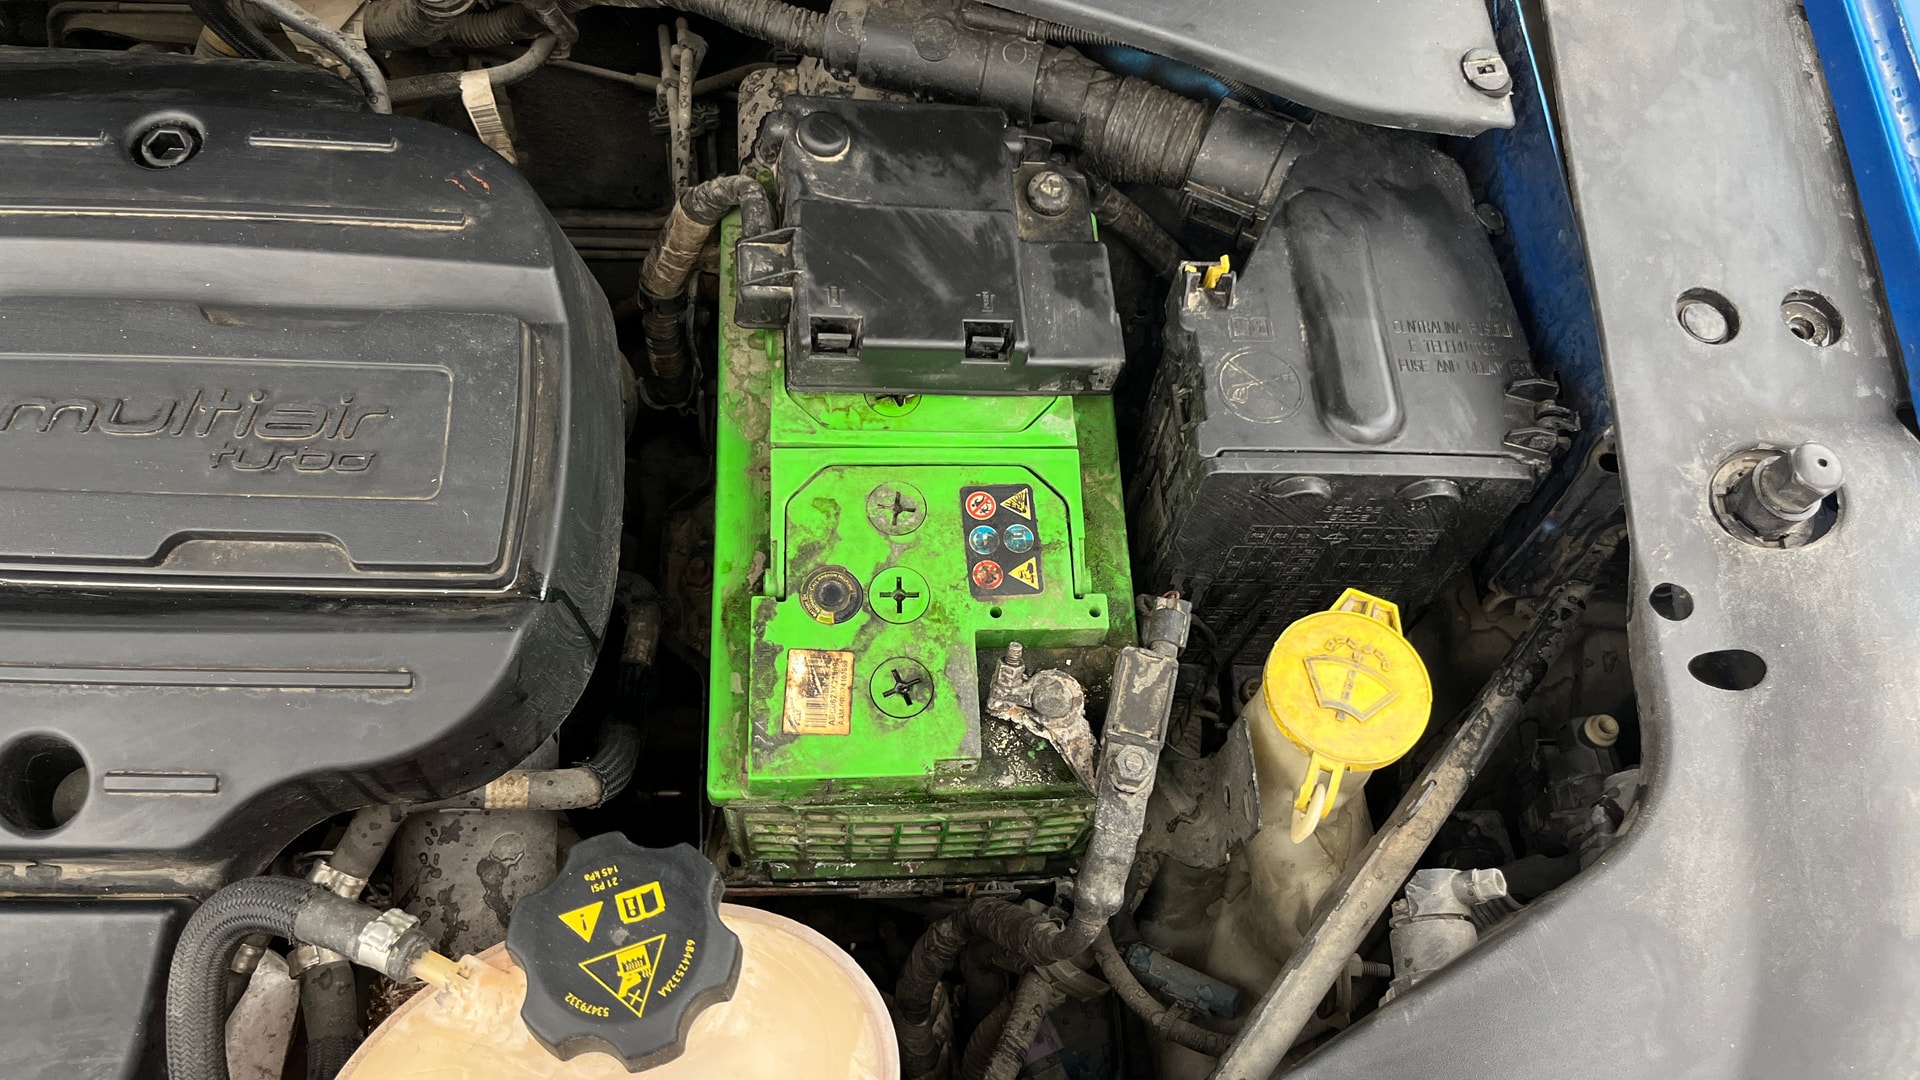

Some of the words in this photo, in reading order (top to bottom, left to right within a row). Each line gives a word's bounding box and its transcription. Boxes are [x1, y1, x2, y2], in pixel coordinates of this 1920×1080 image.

[1398, 359, 1430, 374] FUSE
[0, 387, 390, 440] multiair
[209, 442, 376, 473] turbo
[584, 870, 601, 882] kPa
[602, 865, 619, 877] 145
[590, 880, 605, 893] PSI
[606, 877, 619, 887] 21
[657, 938, 696, 997] 68442532AA
[564, 992, 610, 1018] 53479332
